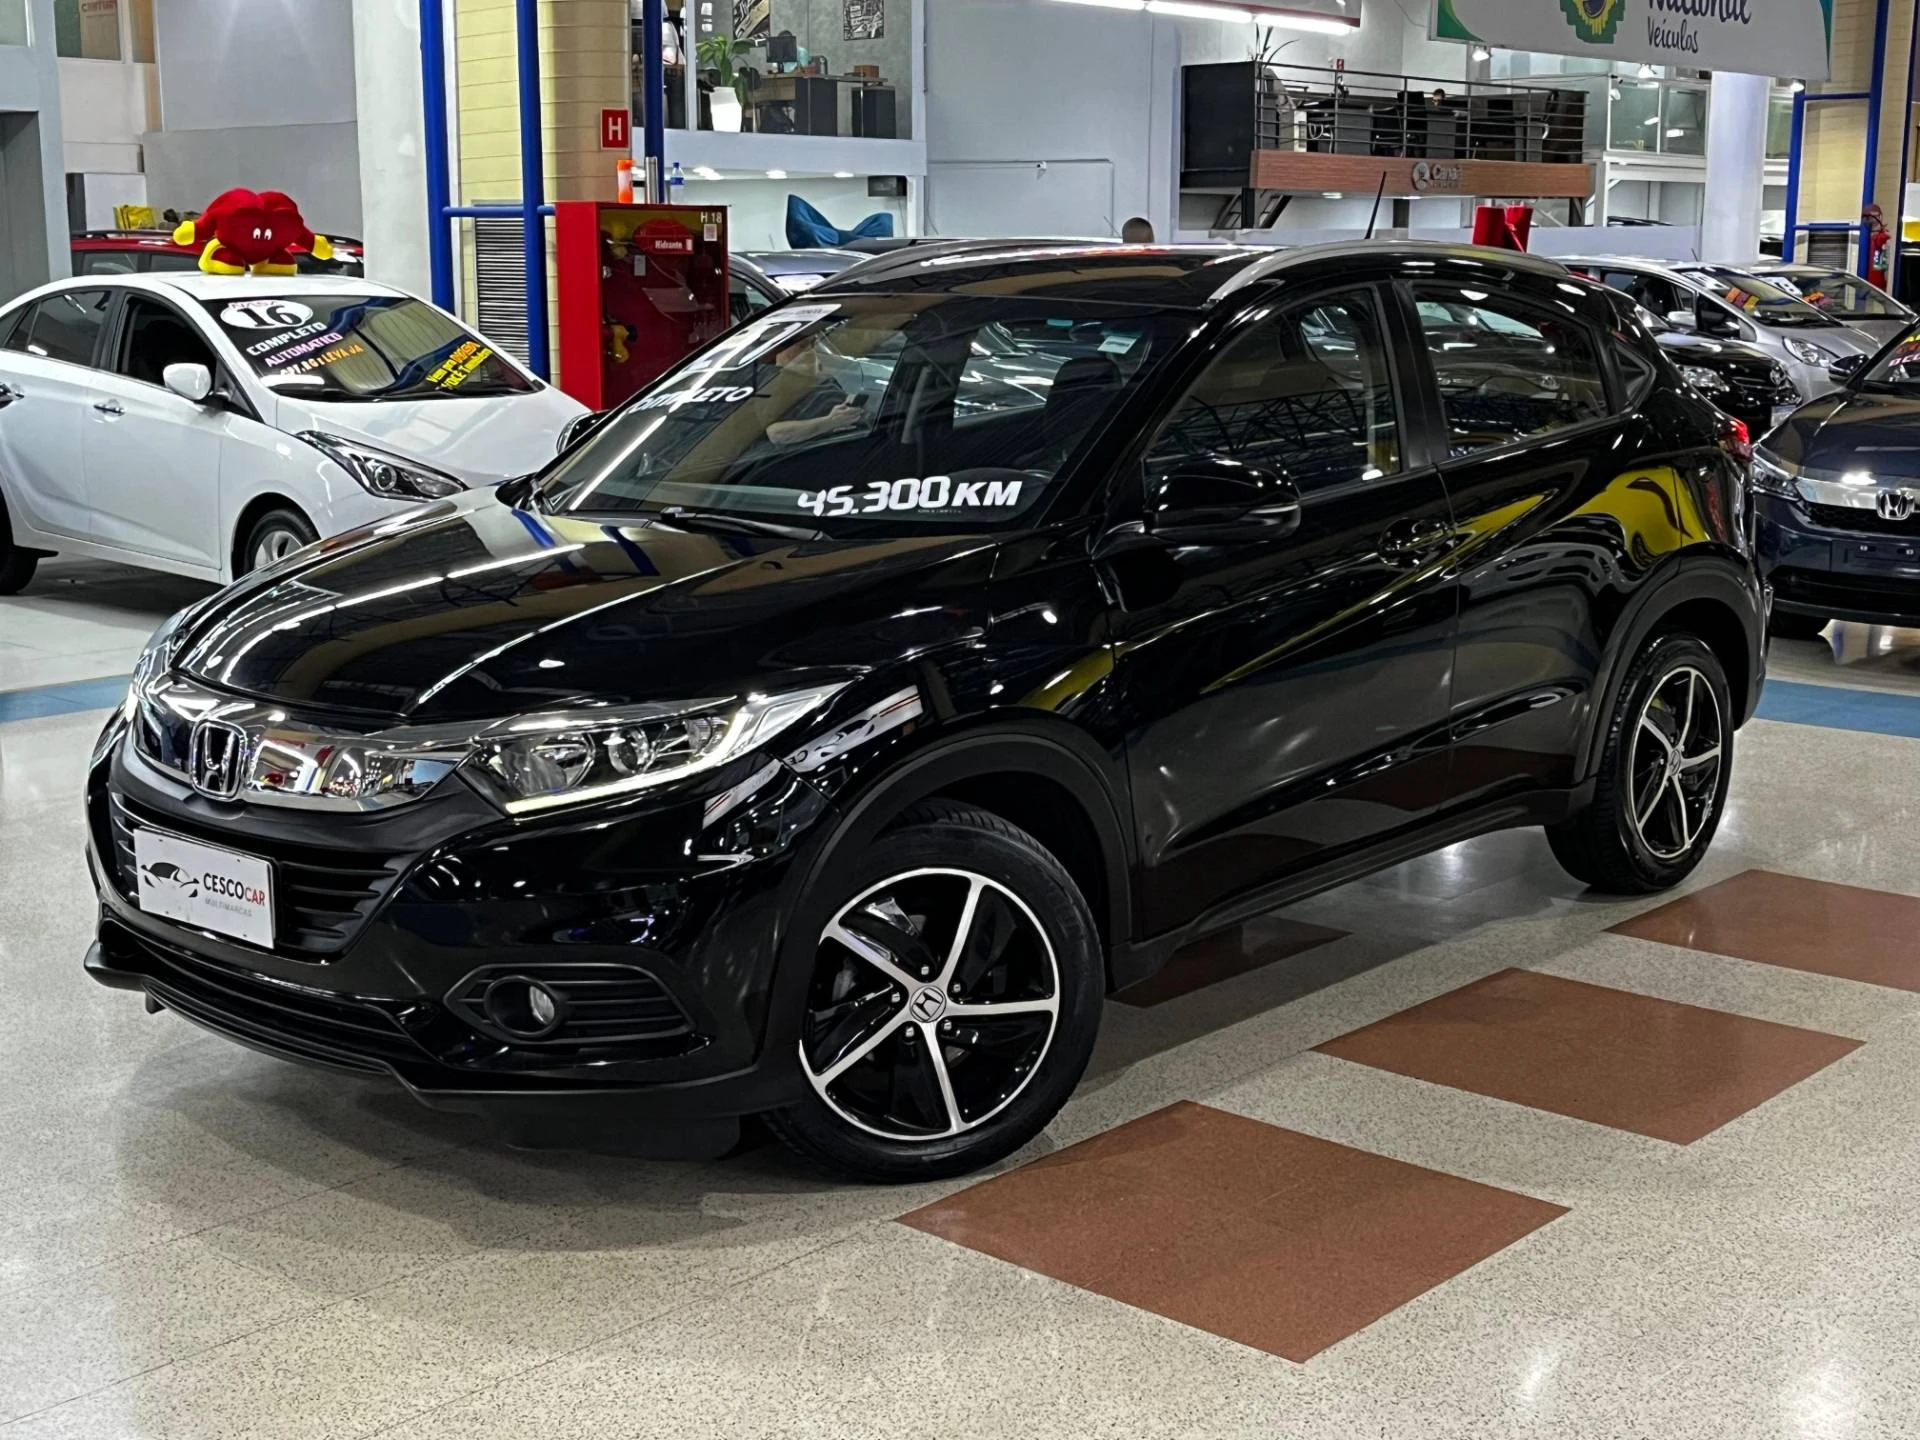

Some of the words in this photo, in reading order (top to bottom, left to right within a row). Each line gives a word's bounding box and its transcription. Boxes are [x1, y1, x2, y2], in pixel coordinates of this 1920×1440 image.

[1647, 15, 1699, 54] Veículos
[608, 116, 622, 141] H
[700, 211, 708, 224] H
[711, 211, 722, 224] 18
[654, 240, 683, 250] Hidrante
[237, 305, 303, 328] 16
[246, 321, 328, 356] COMPLETO
[264, 332, 344, 368] AUTOMATICO
[797, 475, 951, 517] 45.300
[951, 480, 1023, 508] KM
[203, 872, 266, 906] CESCOCAR
[204, 897, 253, 917] MULTIMARCAS
